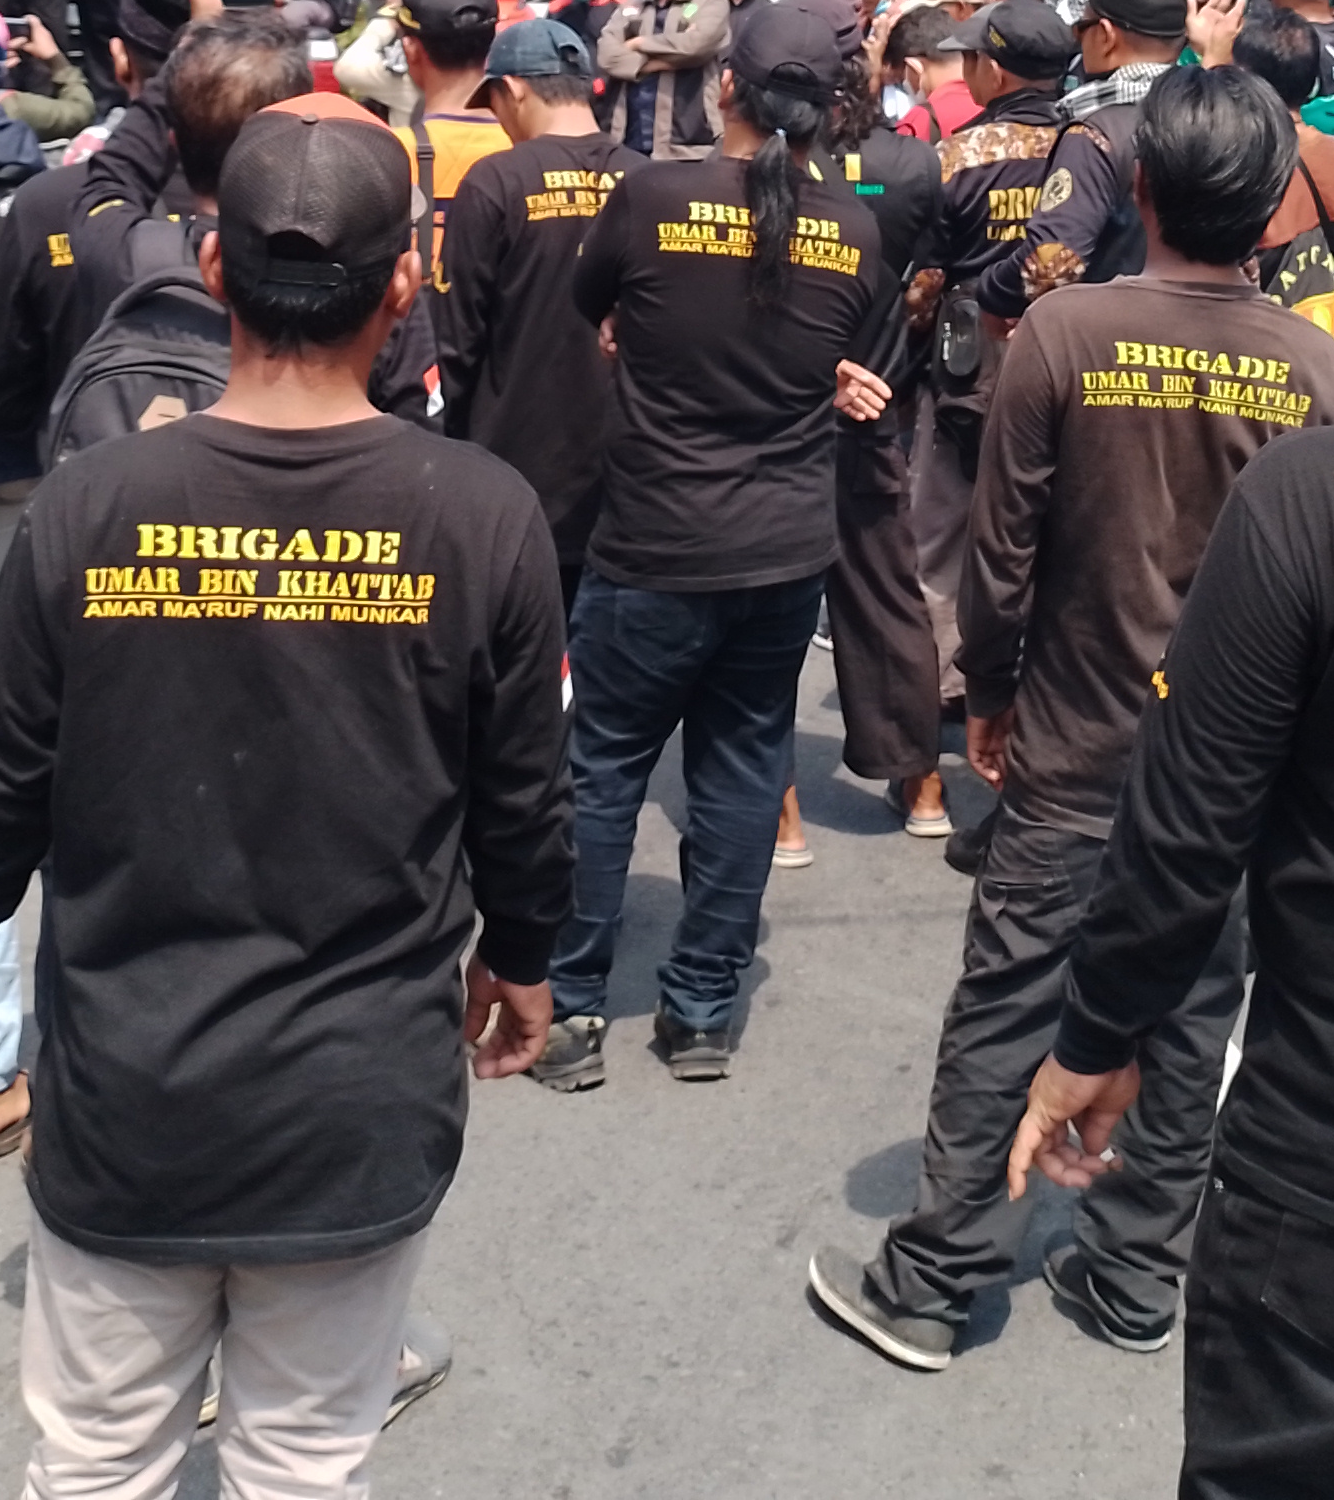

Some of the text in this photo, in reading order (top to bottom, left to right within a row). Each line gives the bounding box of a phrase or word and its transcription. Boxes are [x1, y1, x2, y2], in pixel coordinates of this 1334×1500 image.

[657, 222, 717, 241] UMAR
[688, 201, 841, 242] BRIDE
[987, 225, 1028, 242] UMA
[658, 241, 704, 254] AMAR
[705, 244, 754, 259] MA'RU
[802, 256, 858, 277] MUNKAR
[1114, 341, 1291, 385] BRIGADE
[1081, 370, 1313, 414] UMAR BIN KHATTAB
[1082, 393, 1307, 429] AMAR MA'RUF NAHI MUNKAR
[135, 523, 402, 565] BRIGADE
[84, 566, 437, 601] UMAR BIN KHATTAB
[82, 601, 430, 625] AMAR MA'RUF NAHI MUNKAR
